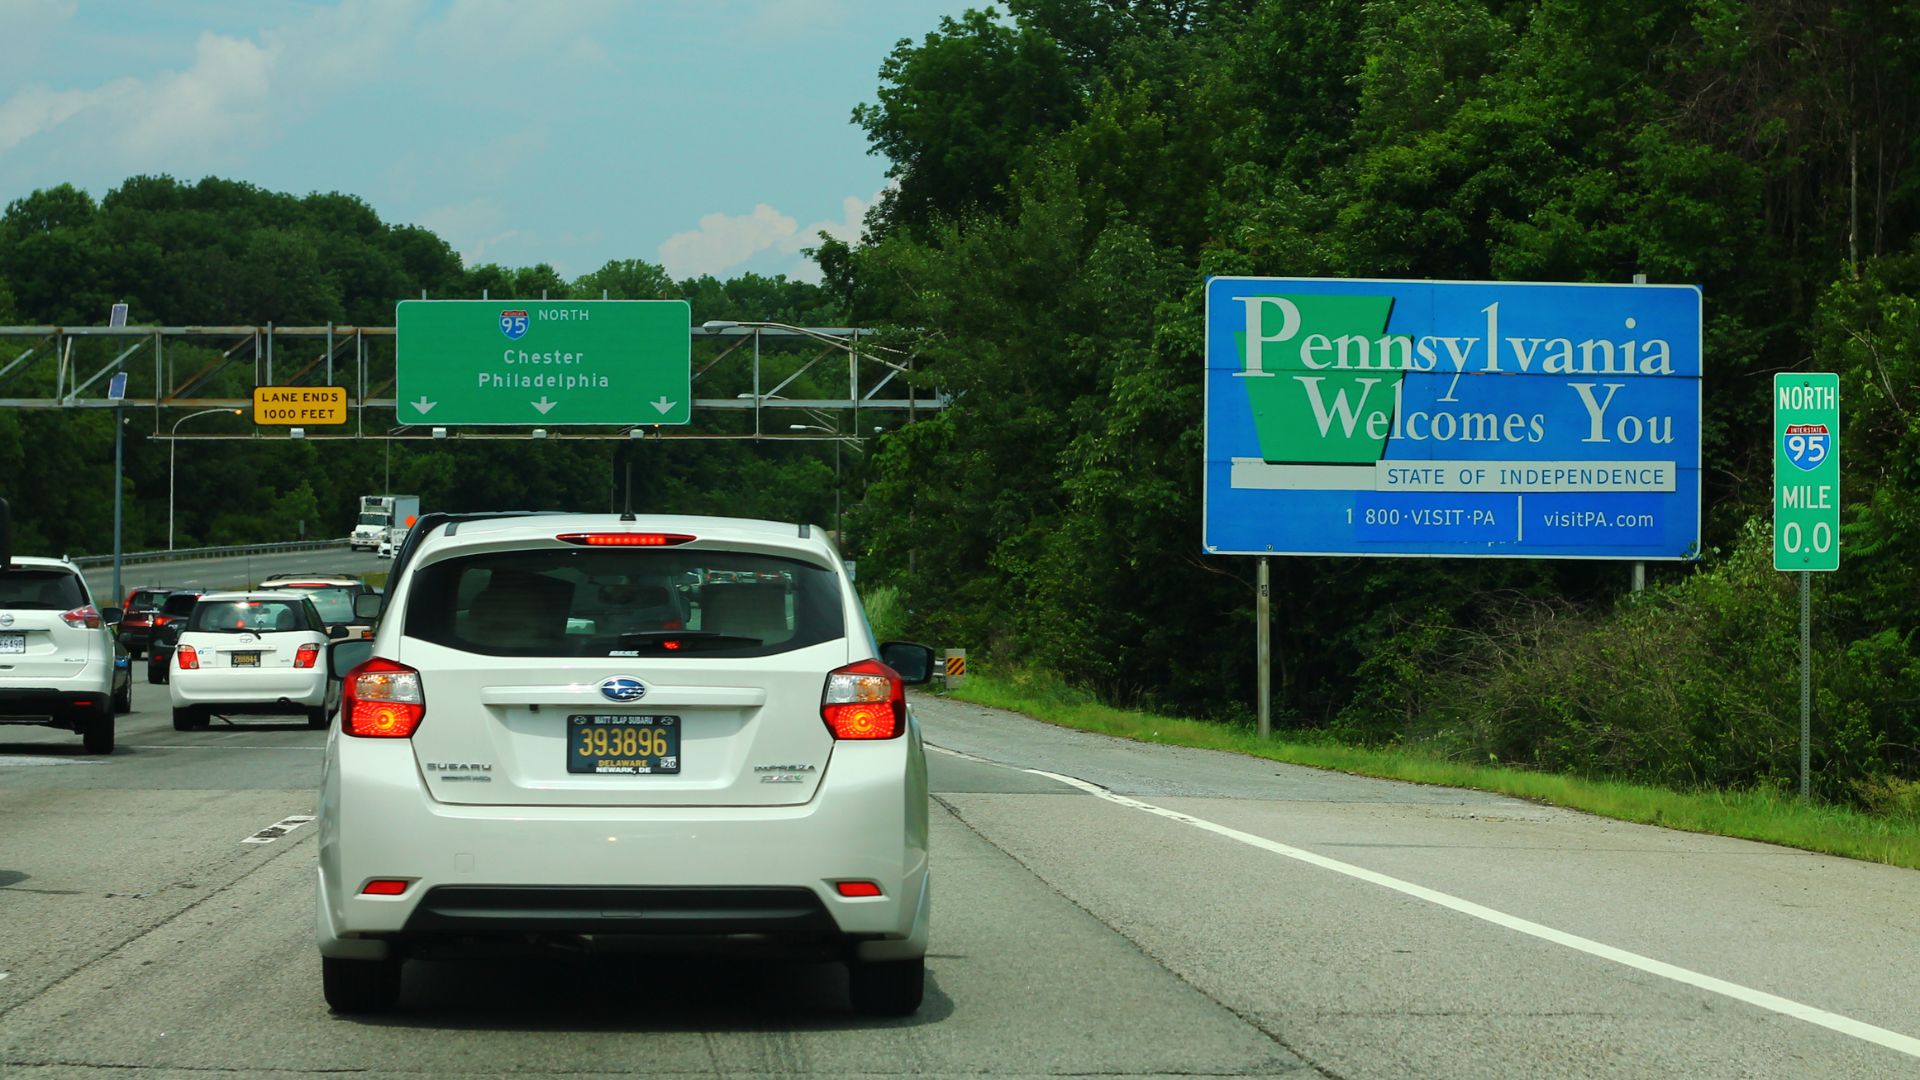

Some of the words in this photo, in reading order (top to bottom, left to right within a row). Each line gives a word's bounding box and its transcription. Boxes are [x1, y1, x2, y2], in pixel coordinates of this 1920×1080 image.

[502, 317, 526, 334] 95
[538, 309, 590, 321] NORTH
[503, 349, 584, 364] Chester
[1231, 296, 1675, 402] Pennsylvania
[478, 372, 610, 390] Philadelphia
[262, 392, 299, 403] LANE
[303, 392, 339, 403] ENDS
[1779, 386, 1835, 411] NORTH
[264, 409, 297, 419] 1000
[301, 409, 335, 419] FEET
[1292, 375, 1545, 442] Welcomes
[1567, 382, 1675, 444] You
[1790, 426, 1823, 434] INTERSTATE
[1788, 435, 1826, 462] 95
[1387, 468, 1445, 485] STATE
[1459, 469, 1486, 485] OF
[1500, 469, 1665, 485] INDEPENDENCE
[1783, 485, 1832, 509] MILE
[1544, 511, 1655, 527] visitPA.com
[1783, 521, 1832, 554] 0.0
[628, 716, 654, 725] SUBARU
[578, 727, 668, 757] 393896
[427, 763, 492, 771] SUBARU
[596, 766, 637, 774] NEWARK,
[597, 759, 649, 767] DELAWARE
